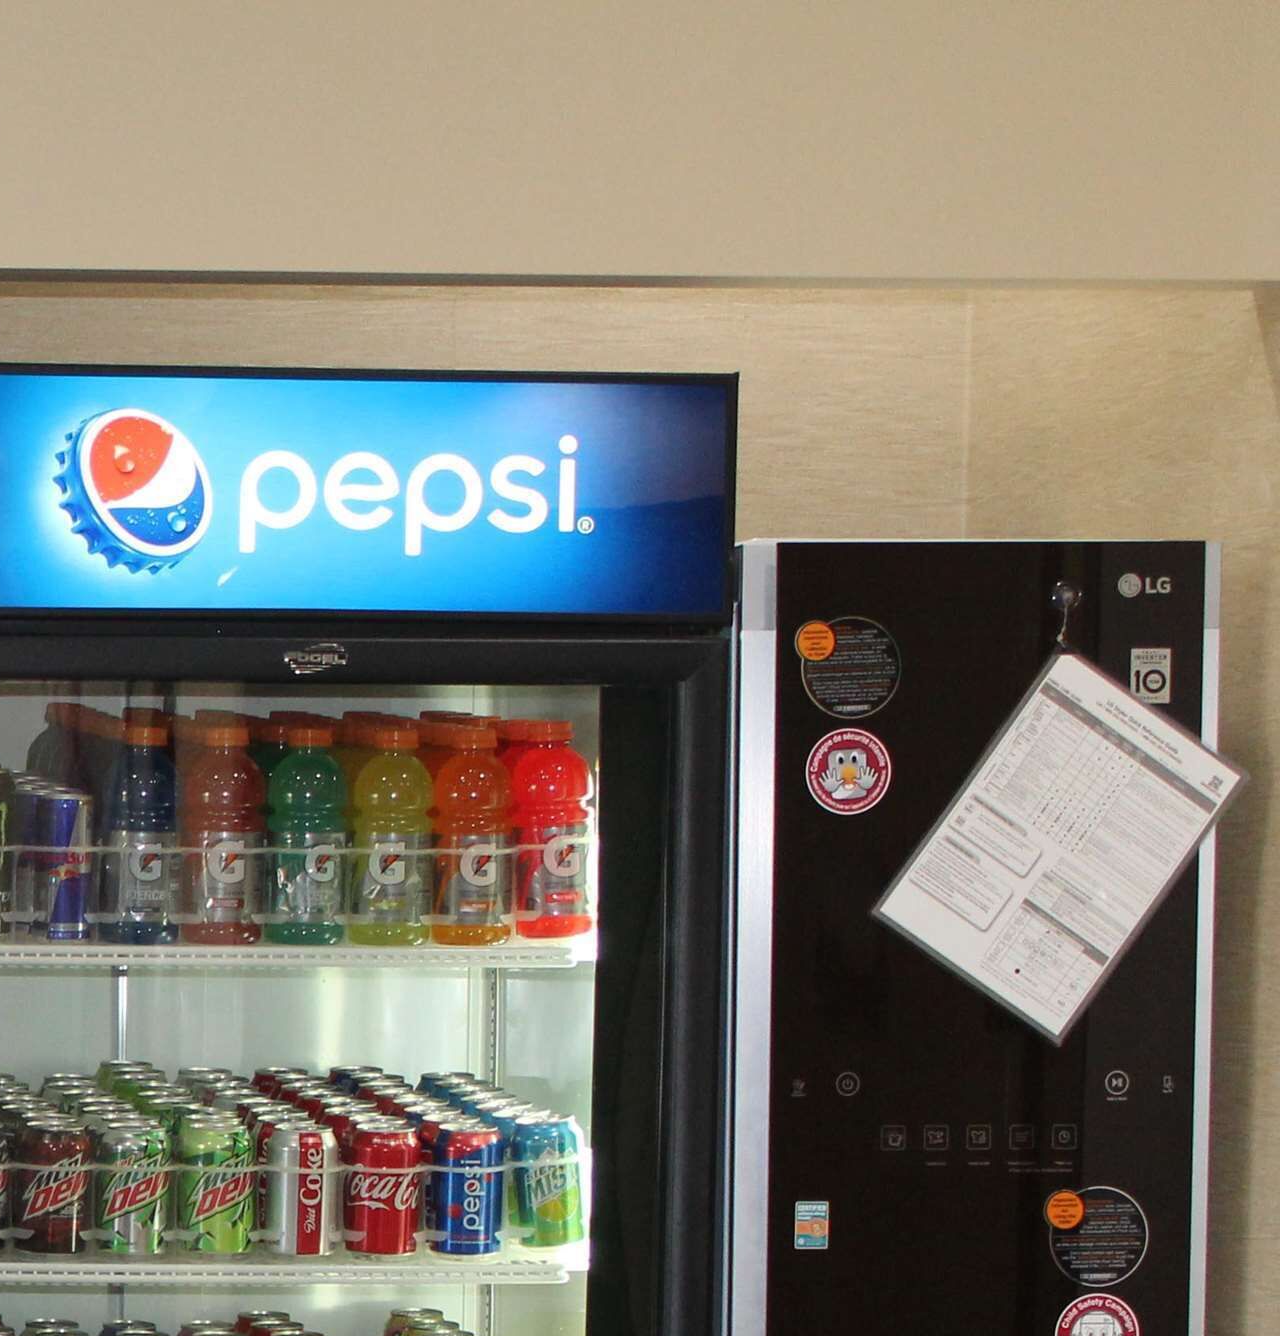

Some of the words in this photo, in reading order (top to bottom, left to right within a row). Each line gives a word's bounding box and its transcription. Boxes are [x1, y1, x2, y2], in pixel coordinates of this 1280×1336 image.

[239, 435, 578, 556] pepsi
[1145, 577, 1171, 594] LG
[300, 1148, 322, 1205] Coke
[461, 1158, 482, 1231] pepsi
